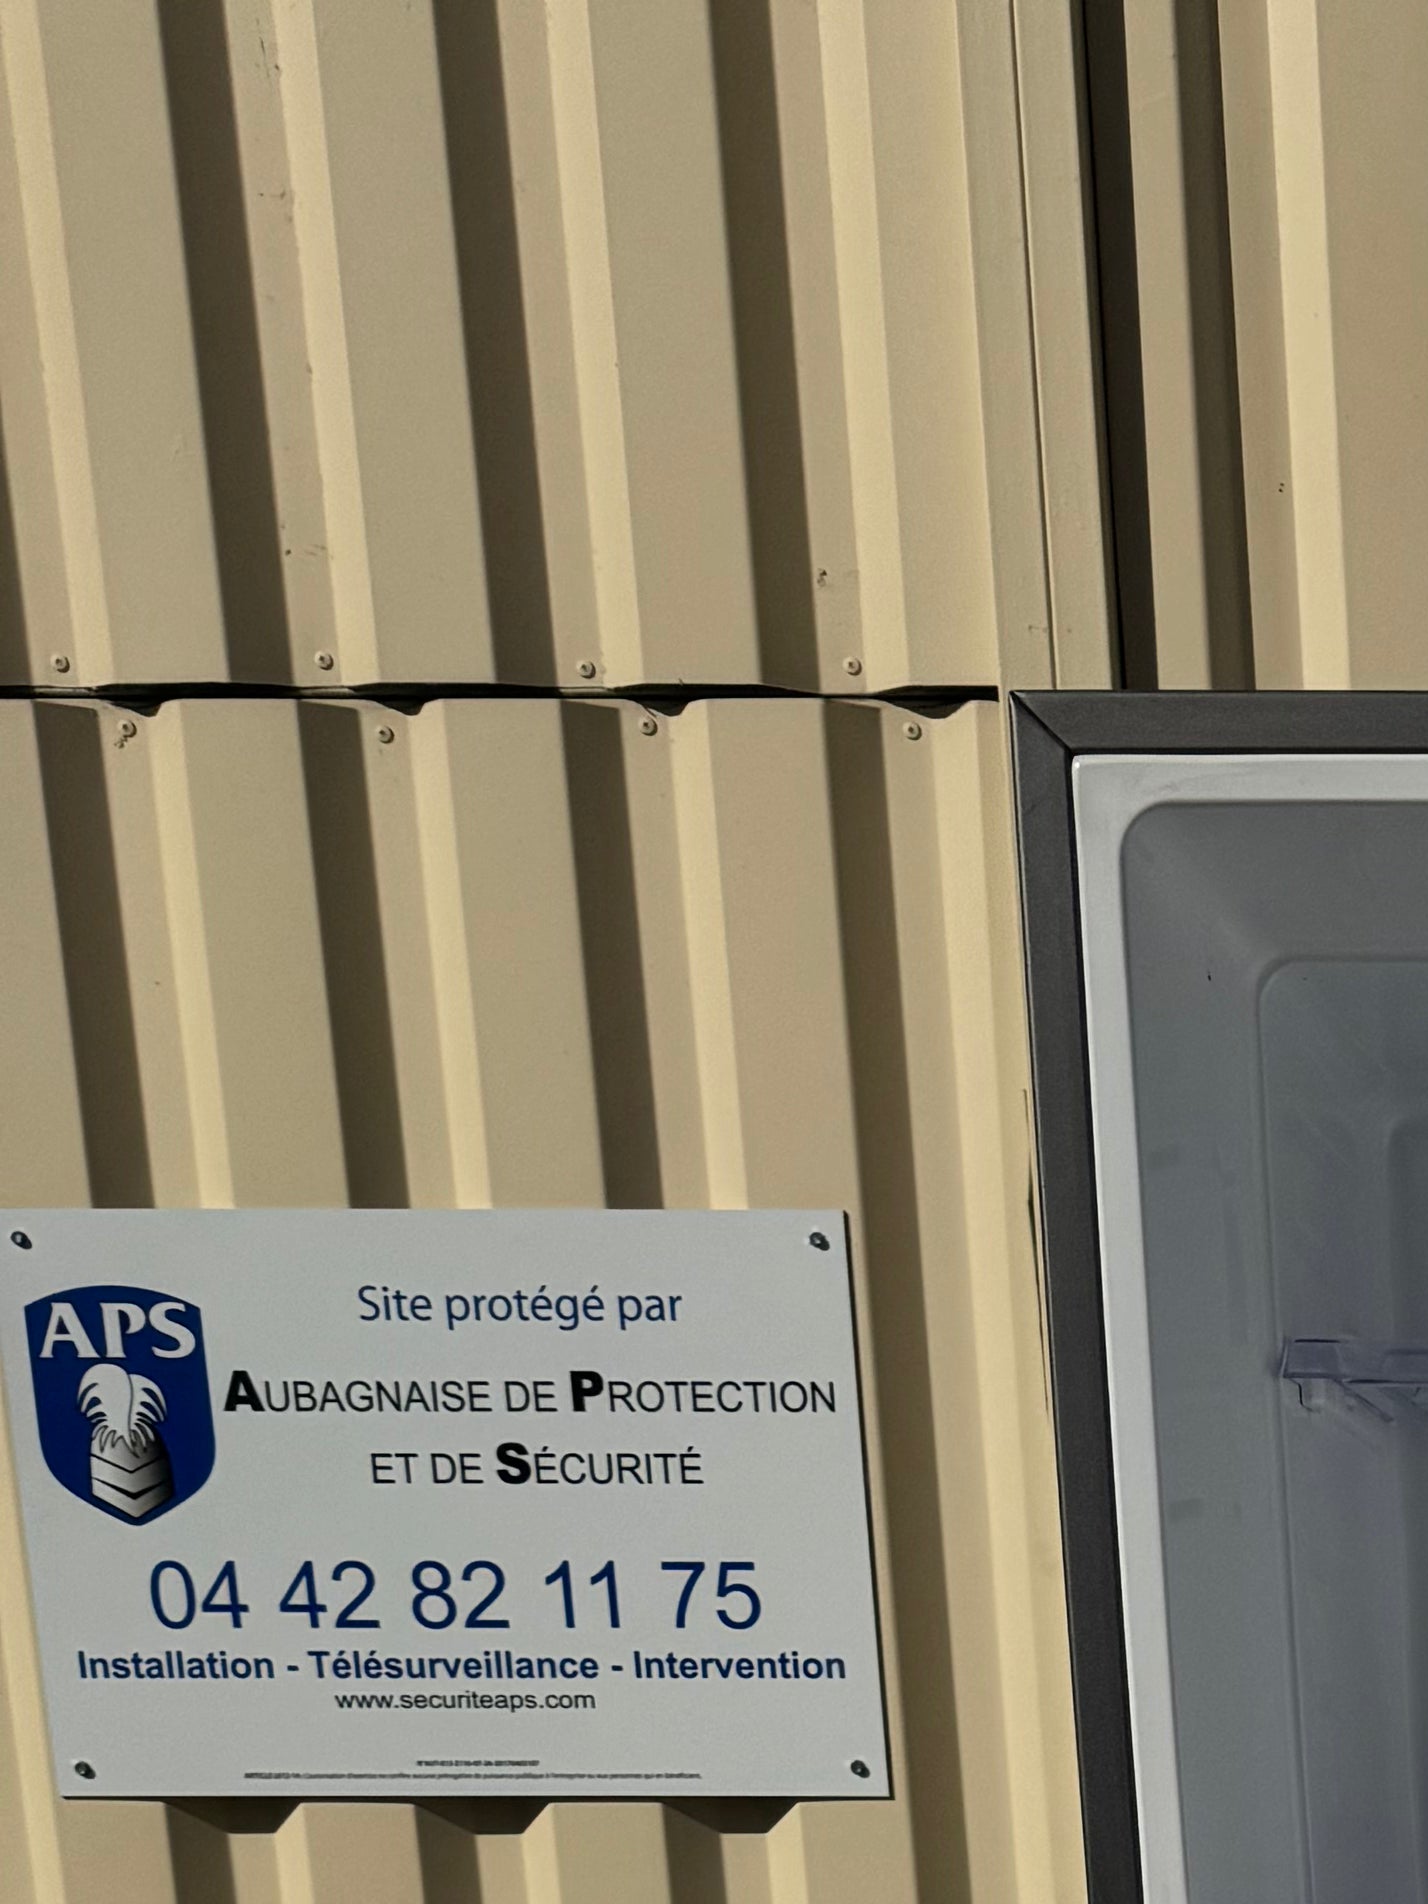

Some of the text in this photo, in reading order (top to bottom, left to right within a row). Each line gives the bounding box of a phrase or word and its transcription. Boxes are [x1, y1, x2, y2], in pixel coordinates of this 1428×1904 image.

[358, 1285, 683, 1331] Site protégé par
[39, 1301, 196, 1359] APS
[224, 1370, 837, 1413] AUBAGNAISE DE PROTECTION
[370, 1442, 704, 1485] ET DE SÉCURITÉ
[150, 1560, 762, 1630] 04 42 82 11 75
[78, 1651, 275, 1679] Installation
[307, 1650, 599, 1680] Télésurveillance
[633, 1650, 846, 1680] Intervention
[334, 1690, 596, 1713] www.securiteaps.com
